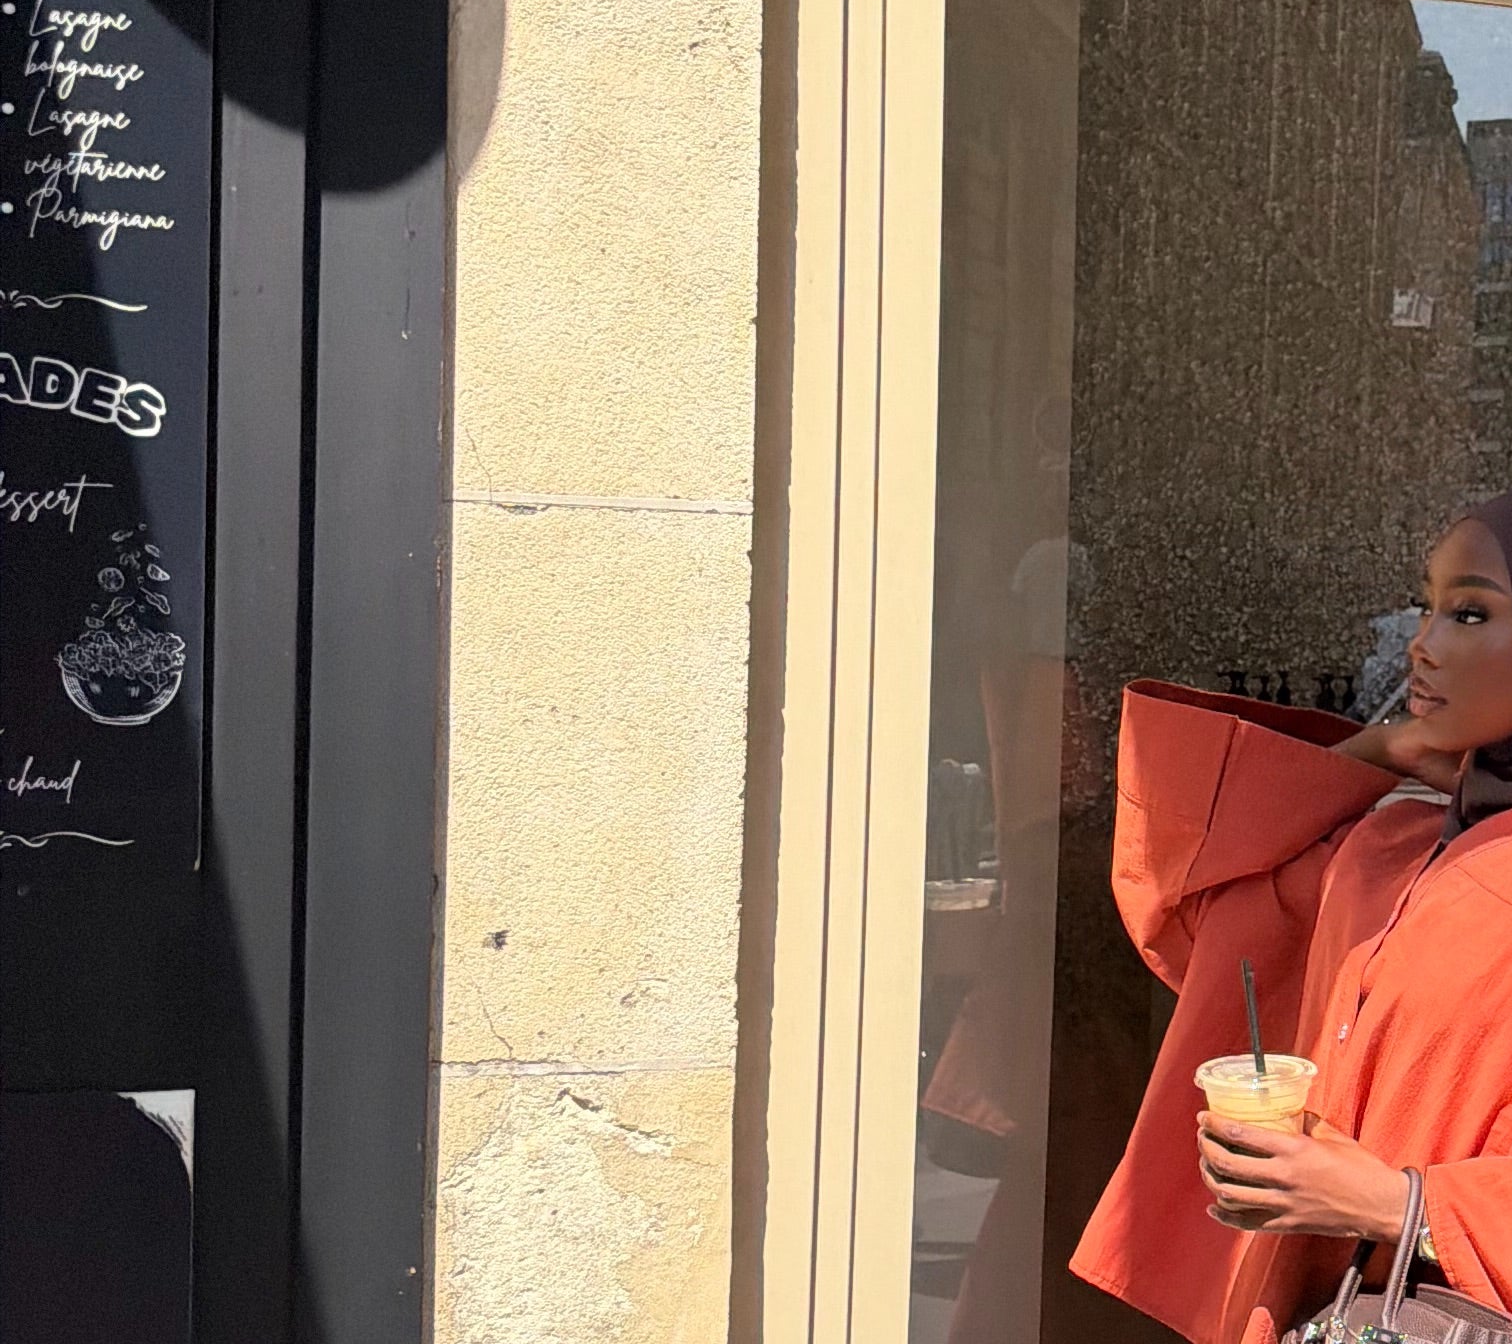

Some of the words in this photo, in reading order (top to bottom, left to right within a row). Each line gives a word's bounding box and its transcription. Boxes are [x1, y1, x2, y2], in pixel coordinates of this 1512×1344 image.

[24, 39, 145, 100] bolognaise
[28, 88, 131, 152] Lasagne
[26, 187, 175, 251] Parmigiana
[7, 755, 82, 804] chaud
